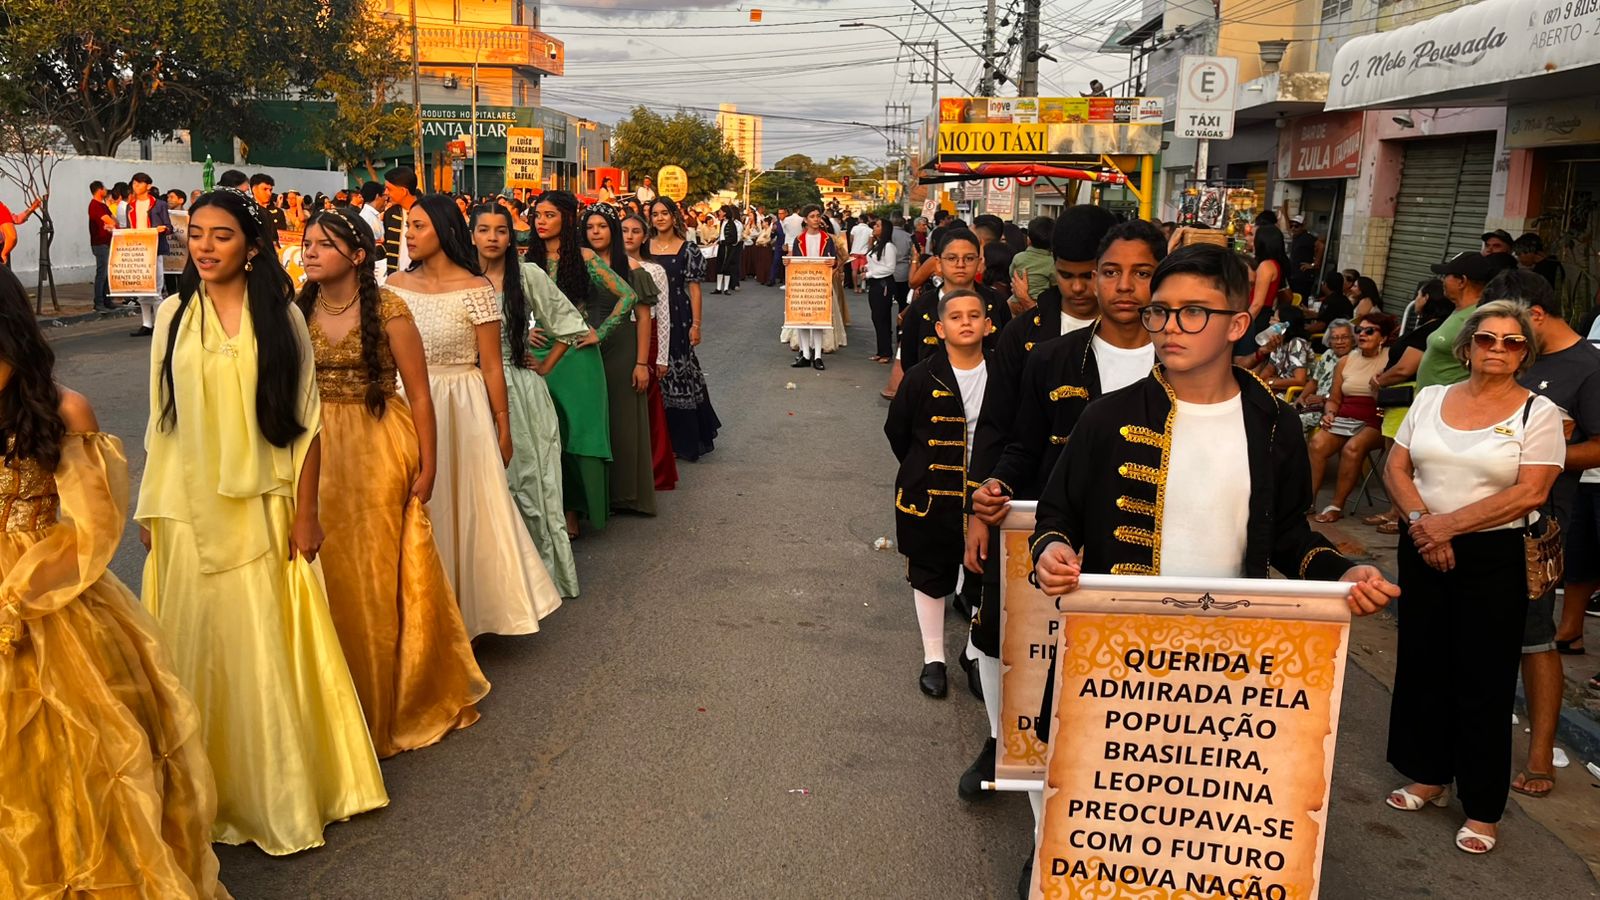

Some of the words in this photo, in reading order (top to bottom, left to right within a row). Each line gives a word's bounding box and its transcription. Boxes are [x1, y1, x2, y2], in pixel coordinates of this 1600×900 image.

[1564, 2, 1572, 20] 9
[1529, 23, 1582, 50] ABERTO
[1342, 60, 1360, 87] J.
[1366, 50, 1407, 78] Melo
[1409, 26, 1508, 70] Pousada
[1201, 71, 1216, 92] E
[422, 110, 456, 118] RODUTOS
[460, 112, 516, 120] HOPITALARES
[1189, 113, 1220, 126] TÁXI
[939, 131, 996, 152] MOTO
[1000, 125, 1045, 152] TÁXI
[1298, 144, 1330, 172] ZUILA
[1124, 648, 1250, 674] QUERIDA
[1259, 654, 1274, 676] E
[1079, 678, 1232, 706] ADMIRADA
[1241, 686, 1310, 710] PELA
[1104, 710, 1277, 742] POPULAÇÃO
[1104, 741, 1270, 775] BRASILEIRA,
[1093, 771, 1274, 804] LEOPOLDINA
[1068, 799, 1294, 840] PREOCUPAVA-SE
[1069, 829, 1132, 853] COM
[1142, 836, 1162, 856] O
[1170, 838, 1286, 872] FUTURO
[1051, 858, 1088, 880] DA
[1097, 862, 1176, 890] NOVA
[1186, 872, 1286, 900] NAÇÃO
